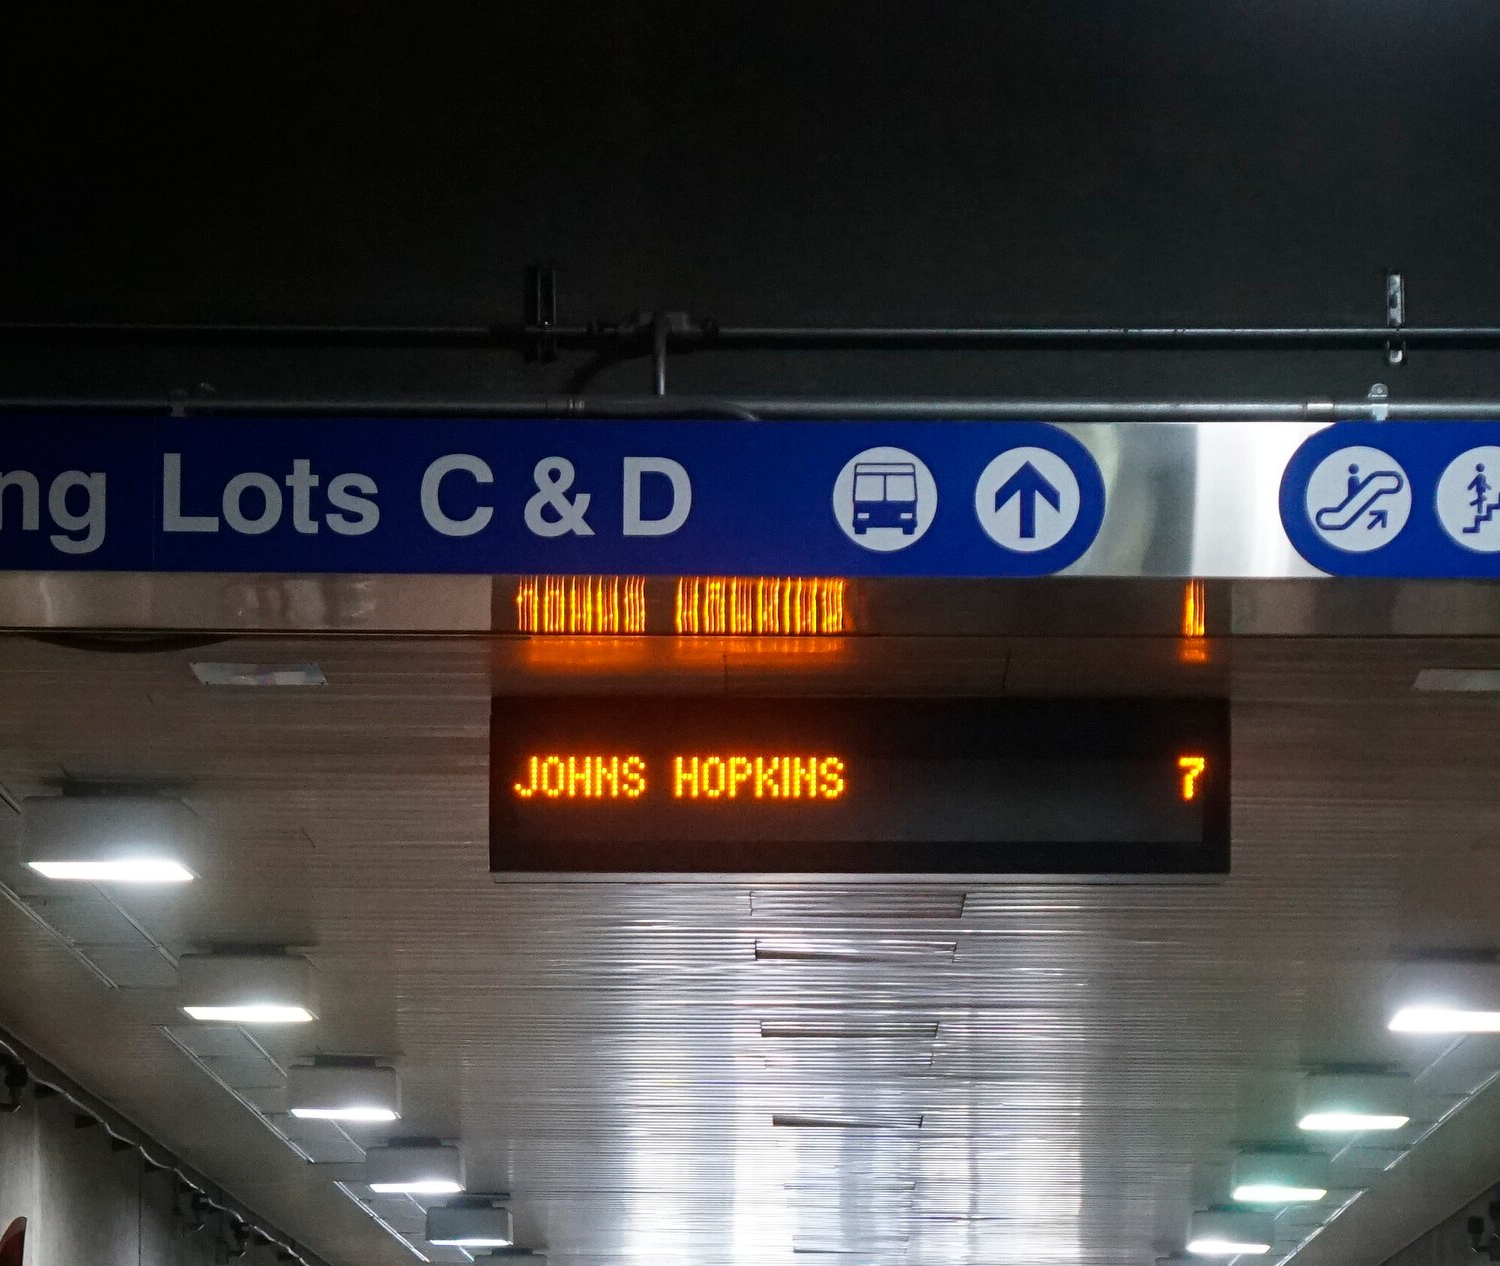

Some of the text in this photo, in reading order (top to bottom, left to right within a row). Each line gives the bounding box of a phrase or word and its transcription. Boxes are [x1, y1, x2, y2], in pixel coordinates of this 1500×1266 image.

[162, 452, 381, 537] Lots
[420, 453, 494, 538] C
[524, 456, 596, 538] &
[622, 456, 692, 537] D
[513, 754, 1206, 801] JOHNS HOPKINS 7
